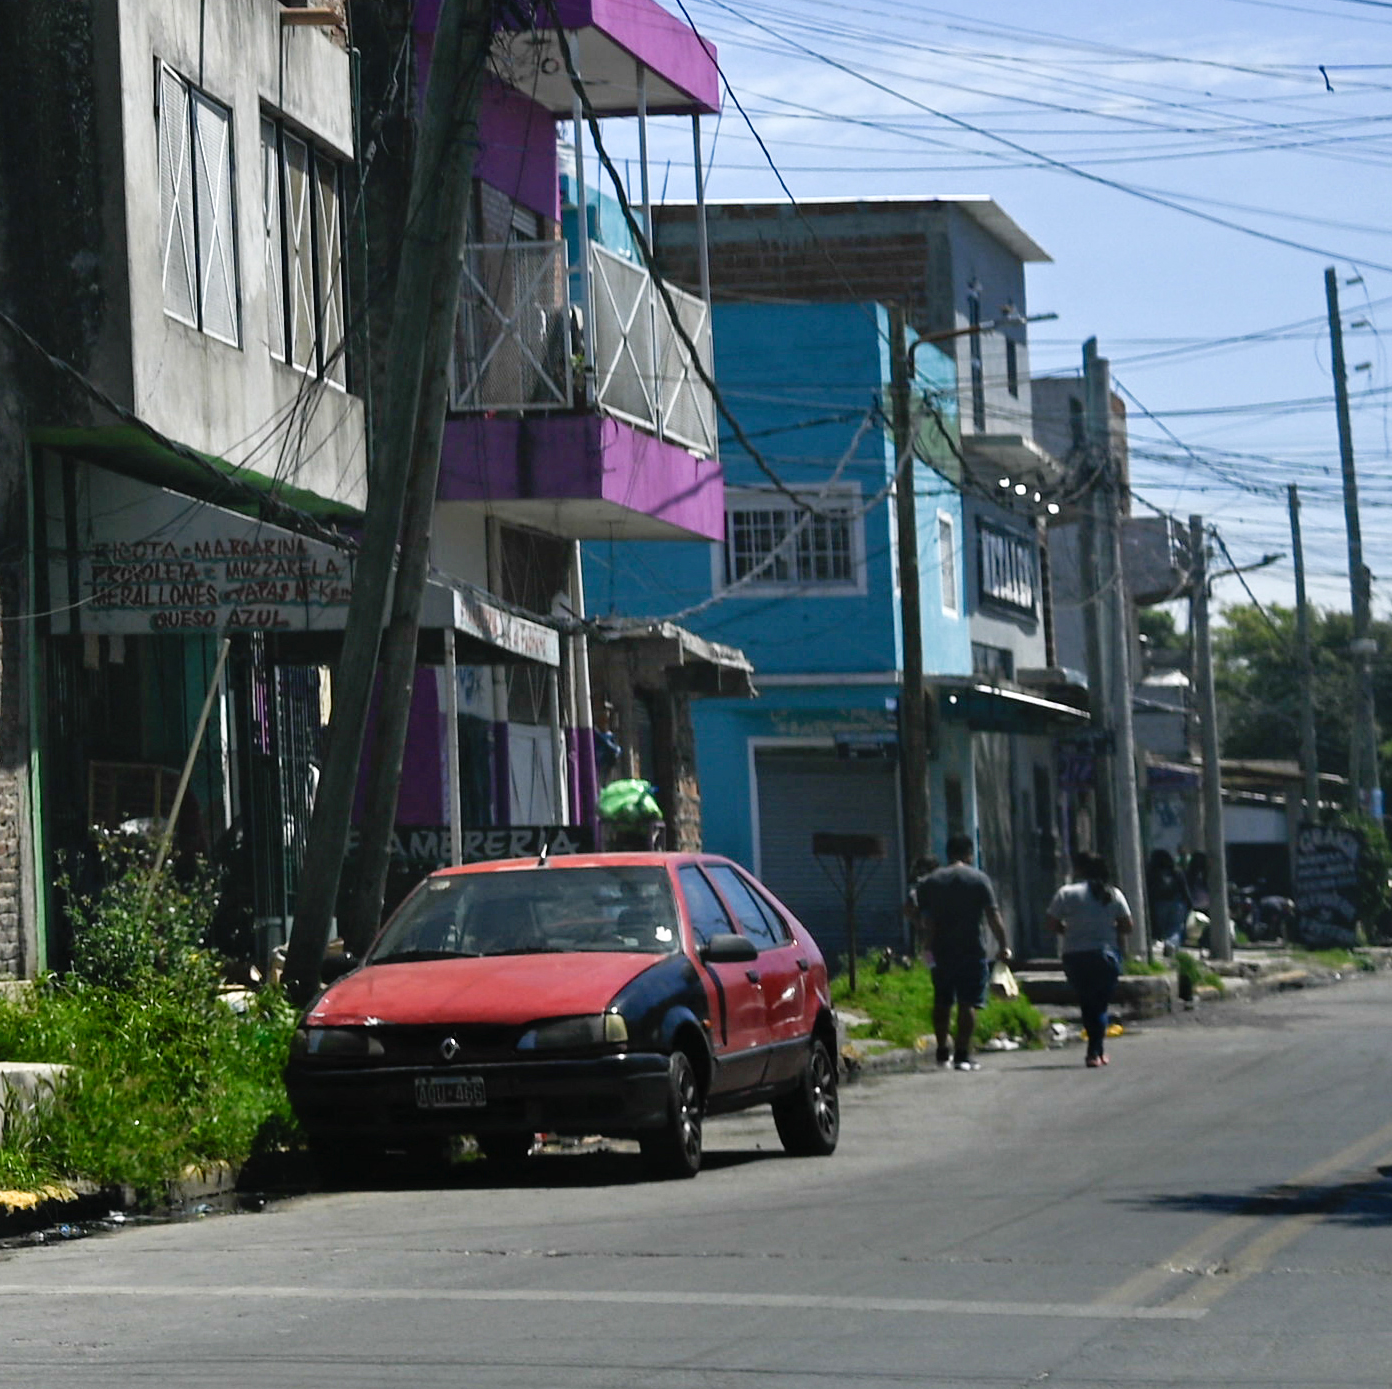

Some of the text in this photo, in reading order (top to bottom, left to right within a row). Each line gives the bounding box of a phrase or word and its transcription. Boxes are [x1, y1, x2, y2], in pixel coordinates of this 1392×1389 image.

[94, 538, 308, 560] RICOTA MARGARINA
[155, 609, 290, 629] QUESO AZUL
[344, 830, 580, 858] FAMBRERIA
